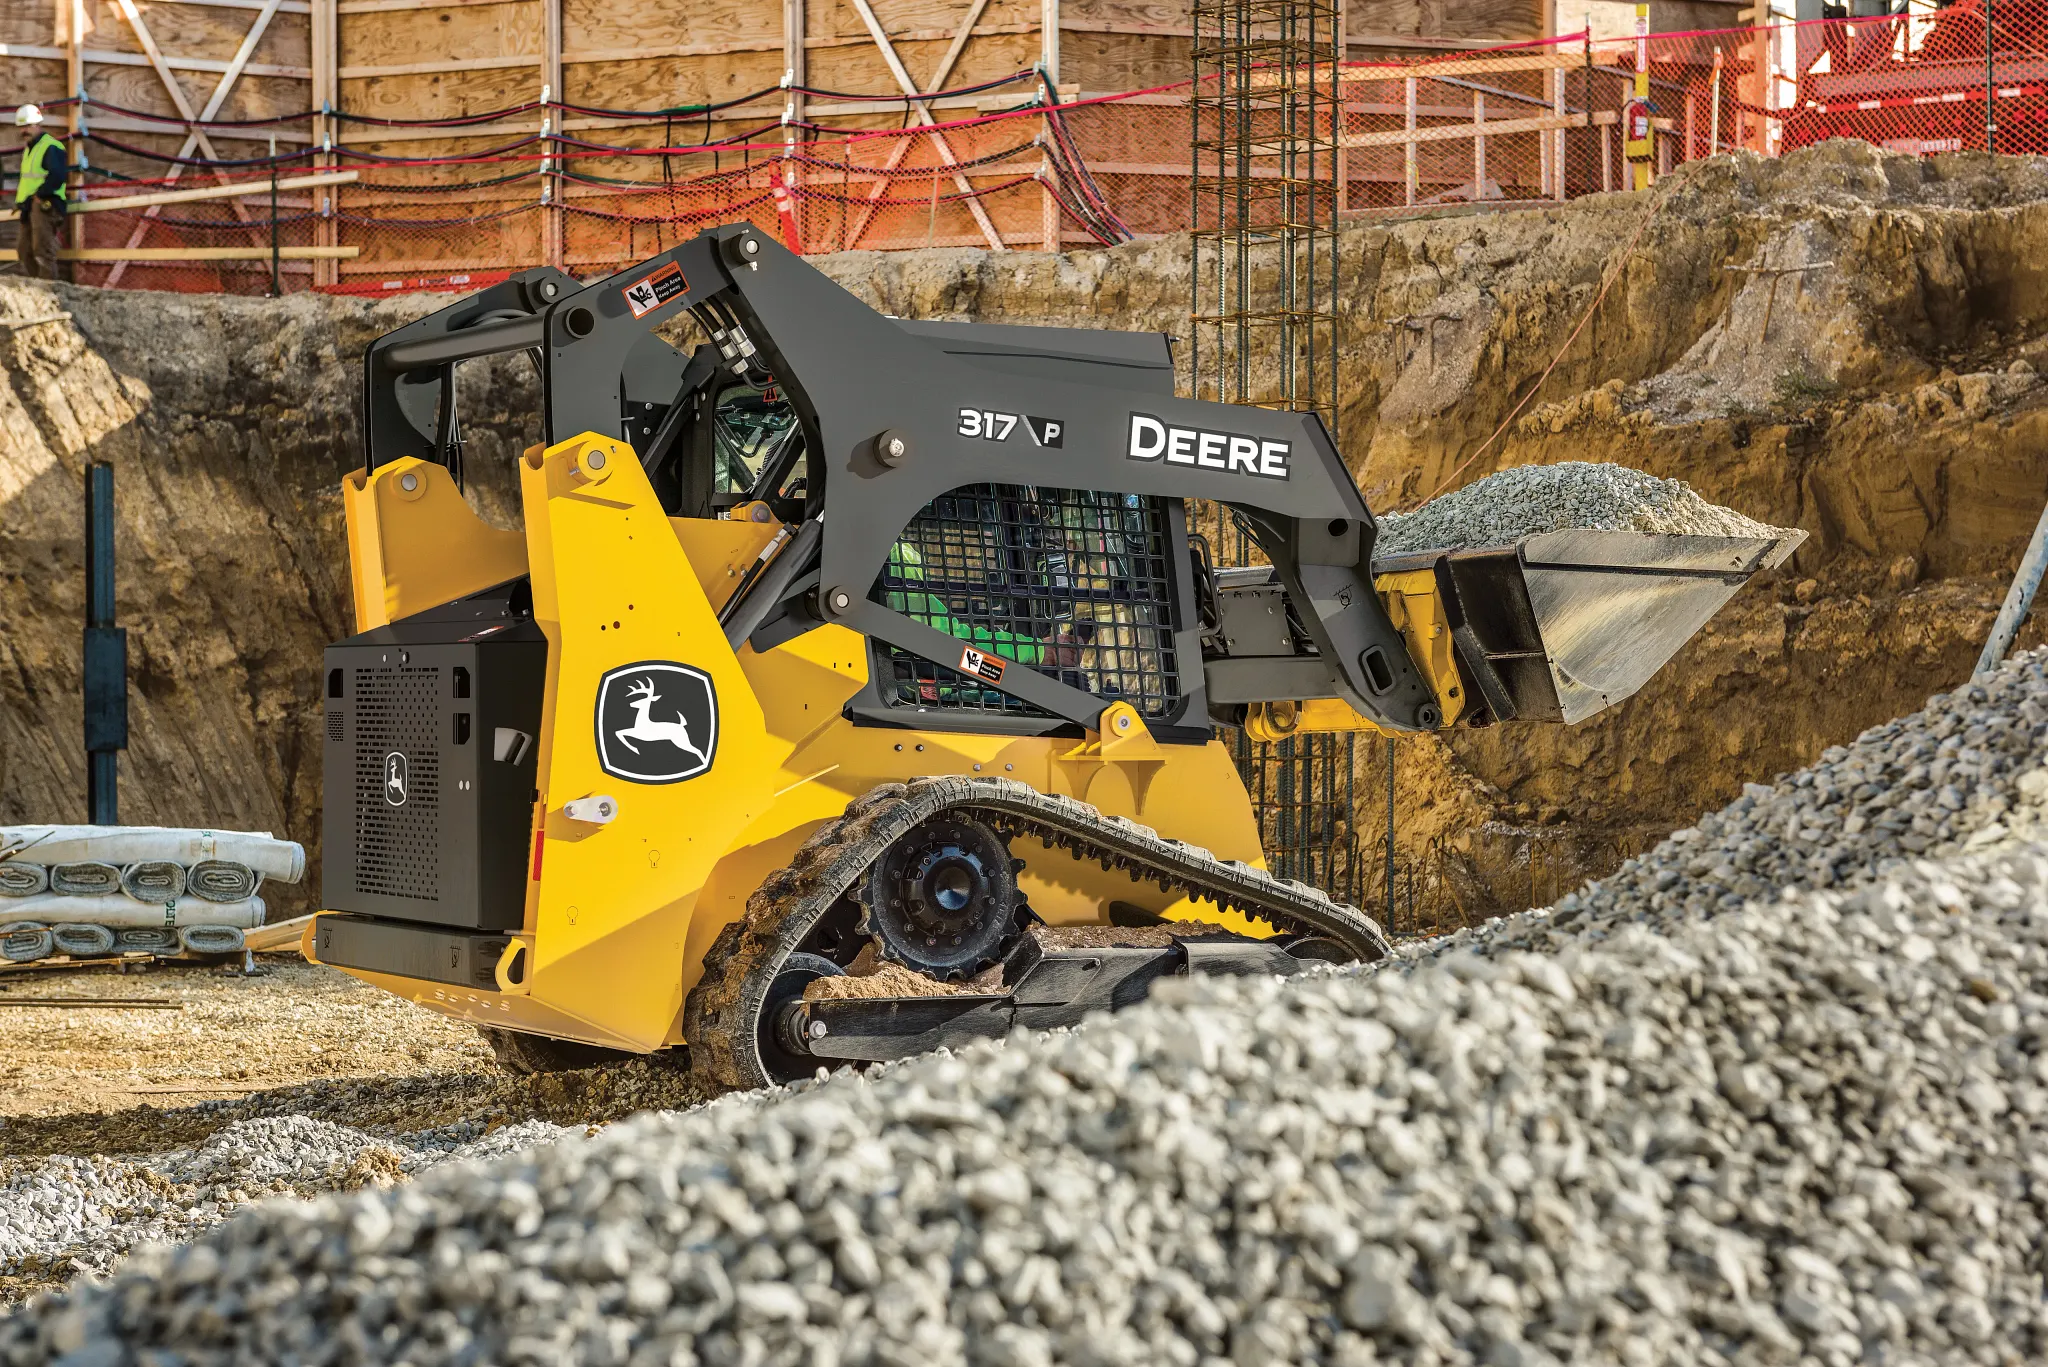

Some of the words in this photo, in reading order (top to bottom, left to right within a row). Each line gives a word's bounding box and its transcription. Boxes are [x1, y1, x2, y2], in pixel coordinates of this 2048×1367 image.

[655, 265, 677, 280] WARNING
[655, 282, 670, 293] Pinch
[669, 276, 682, 285] Area
[658, 290, 670, 299] Keep
[669, 284, 681, 293] Away
[958, 408, 1018, 441] 317
[1129, 414, 1290, 477] DEERE
[981, 663, 992, 672] Pinch
